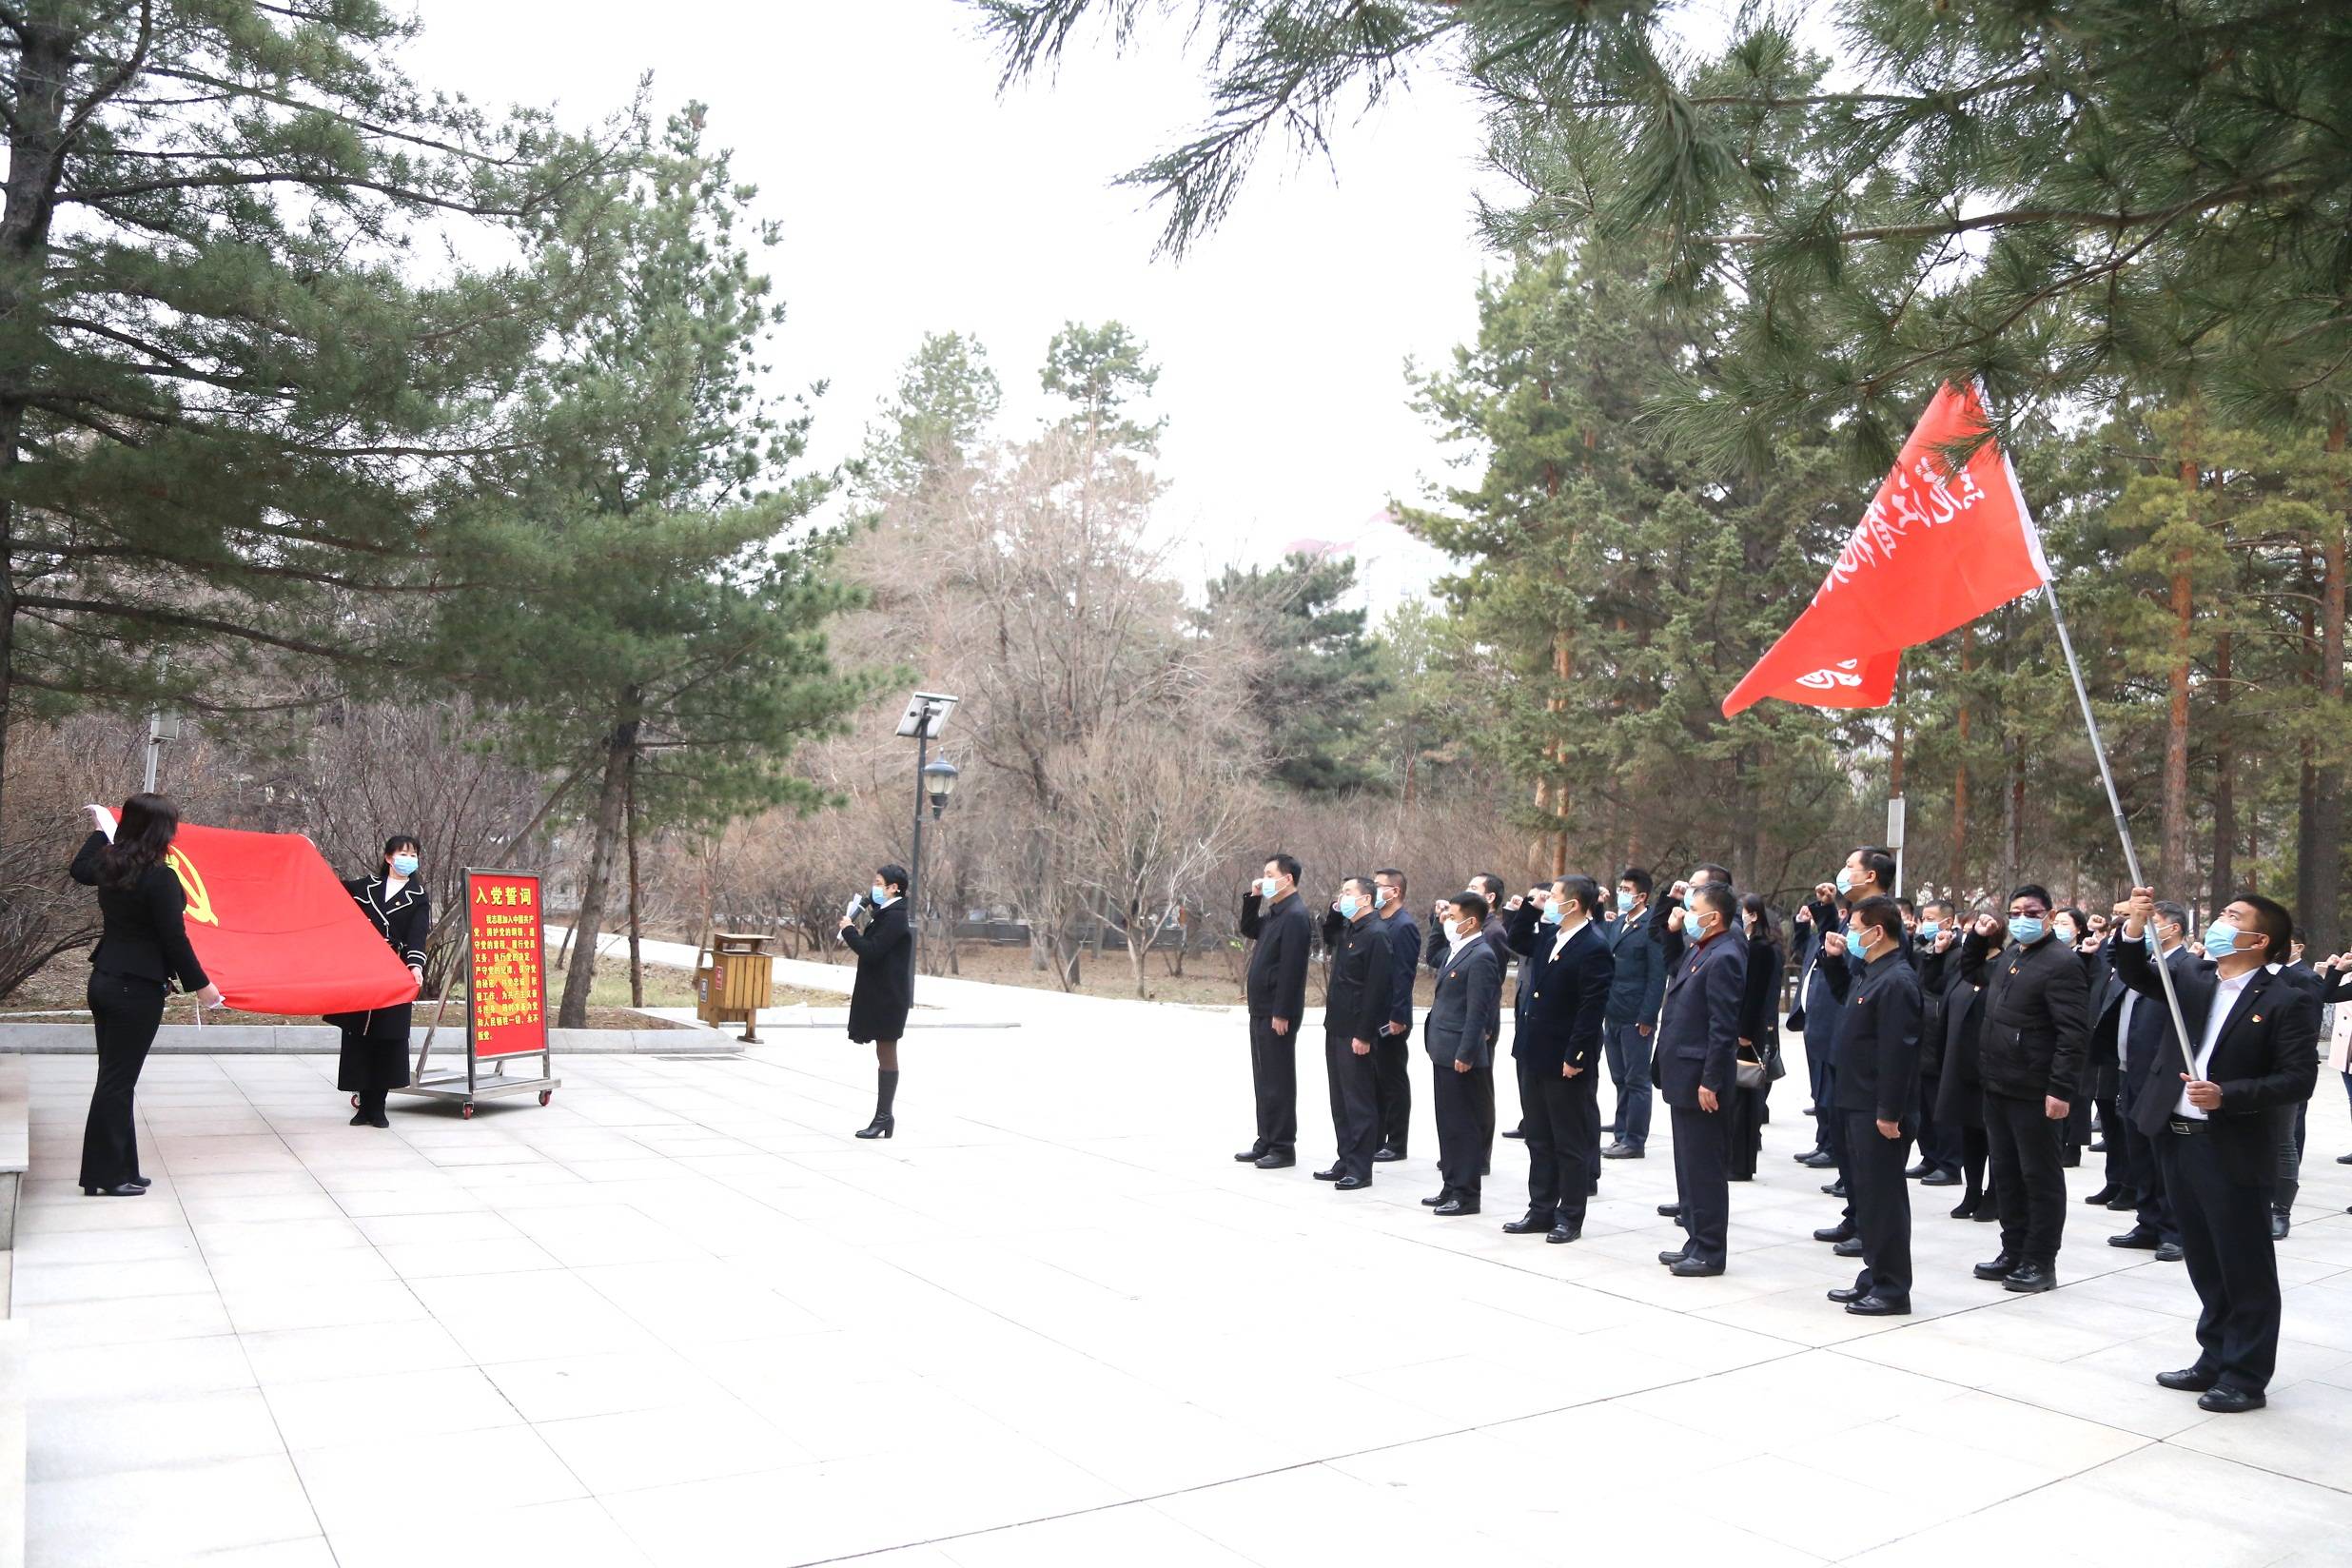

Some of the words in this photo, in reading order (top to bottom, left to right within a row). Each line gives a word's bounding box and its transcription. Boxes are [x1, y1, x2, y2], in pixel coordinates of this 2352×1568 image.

[476, 886, 532, 906] 入党誓词
[485, 914, 535, 924] 我志愿加入中国共产
